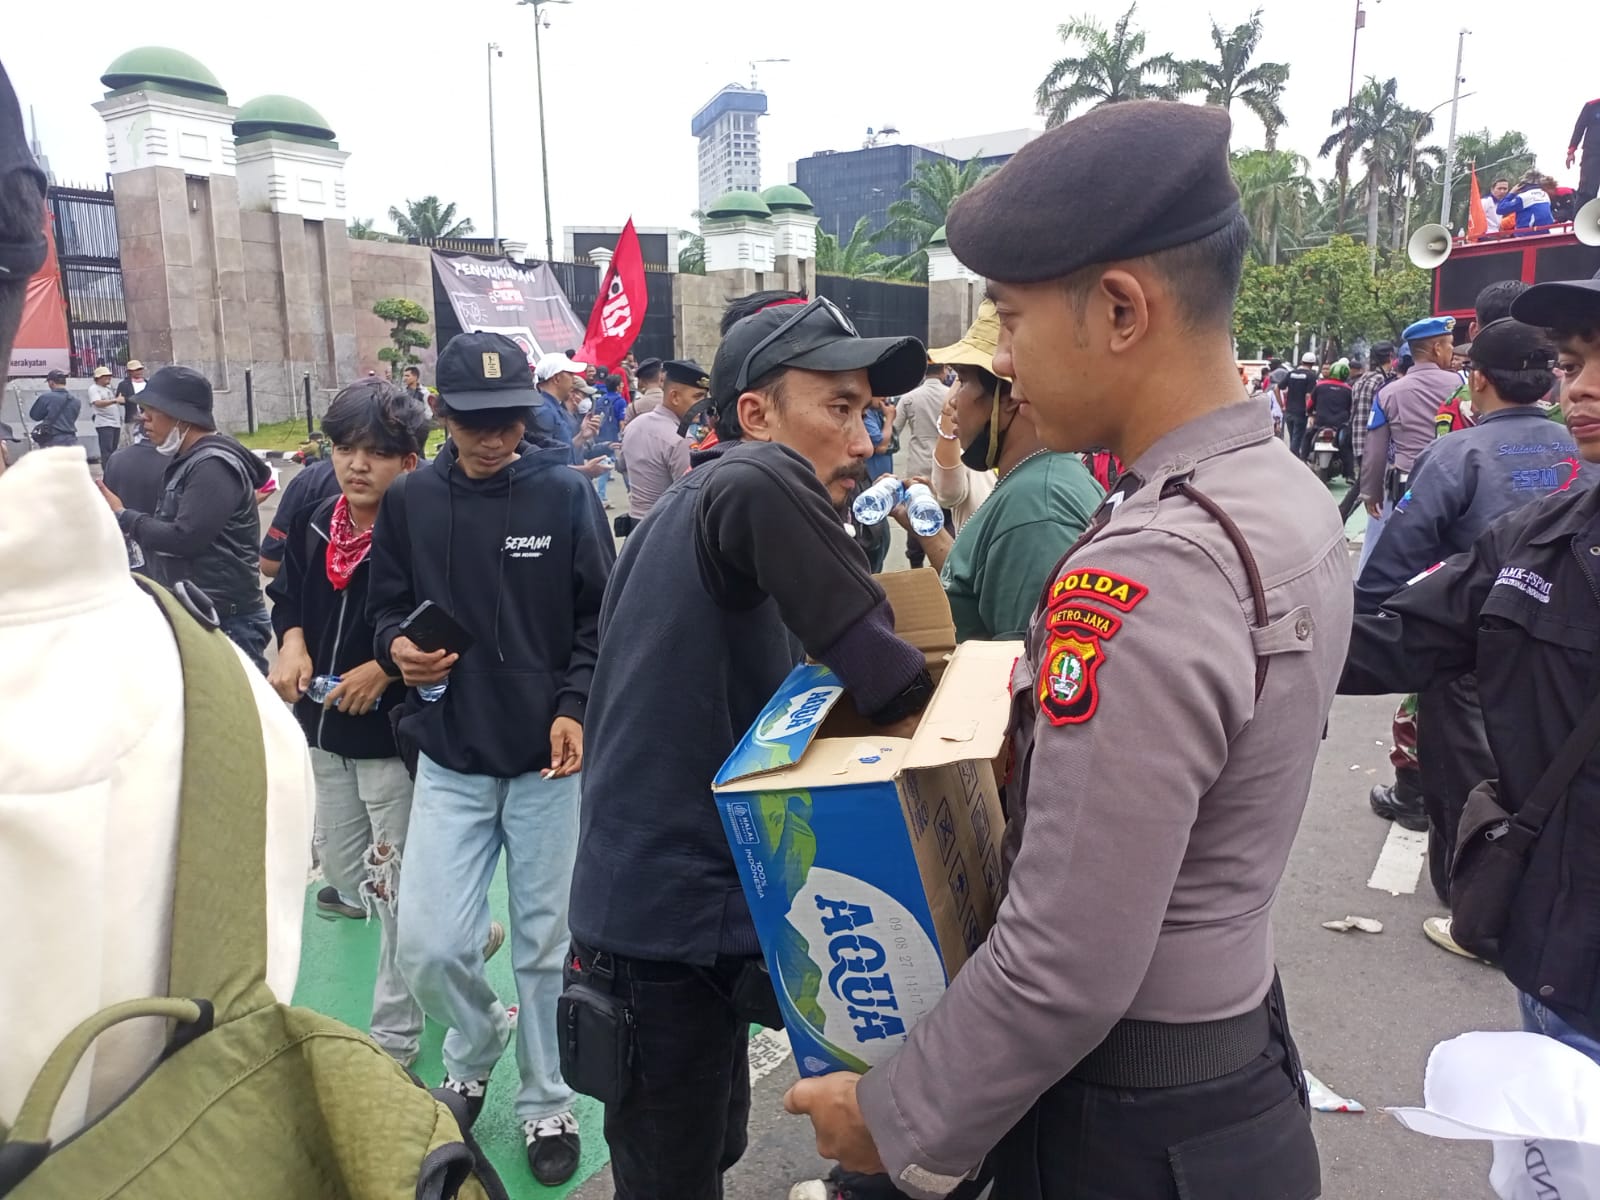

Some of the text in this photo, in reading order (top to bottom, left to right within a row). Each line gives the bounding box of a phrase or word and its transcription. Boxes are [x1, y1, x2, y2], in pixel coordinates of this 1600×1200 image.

[1511, 468, 1559, 488] FSPMI
[1053, 573, 1130, 602] POLDA
[1051, 609, 1110, 632] METRO JAYA
[785, 690, 833, 730] AQUA
[742, 816, 755, 842] HALAL
[744, 848, 765, 899] INDONESIA
[756, 860, 768, 887] 100%
[814, 894, 906, 1043] AQUA
